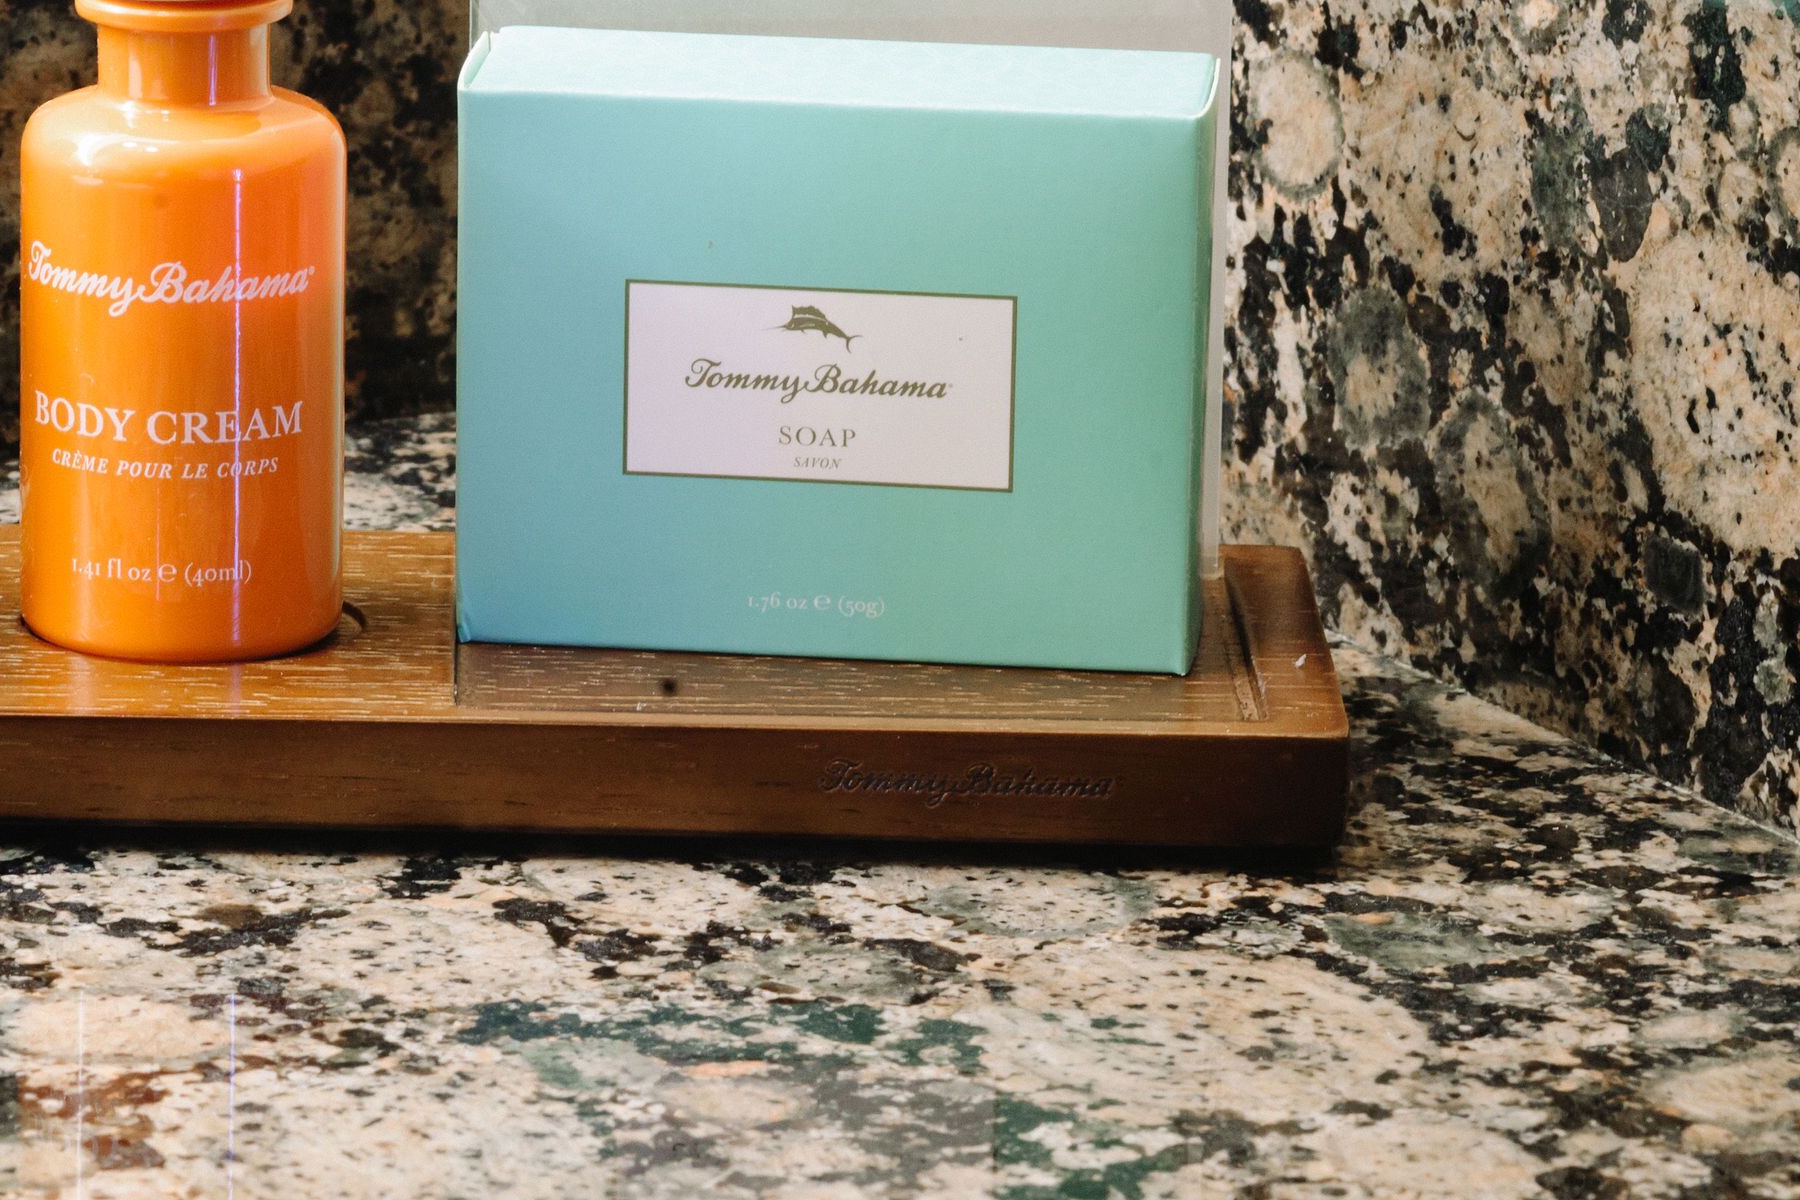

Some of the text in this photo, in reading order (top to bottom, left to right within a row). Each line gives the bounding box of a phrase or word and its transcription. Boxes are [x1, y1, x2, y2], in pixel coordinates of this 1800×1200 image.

[28, 241, 141, 318] Tommy
[685, 358, 806, 404] Tommy
[35, 390, 303, 445] BODY CREAM
[778, 425, 856, 448] SOAP
[52, 448, 278, 479] CRÈME POUR LE CORPS
[793, 456, 842, 470] SAVON
[71, 558, 101, 578] 1.41
[107, 559, 121, 579] fl
[128, 567, 151, 581] oz
[184, 559, 252, 586] (40ml)
[748, 591, 781, 613] 1.76
[786, 598, 808, 609] oz
[838, 596, 885, 618] (50g)
[817, 759, 953, 809] Tommy
